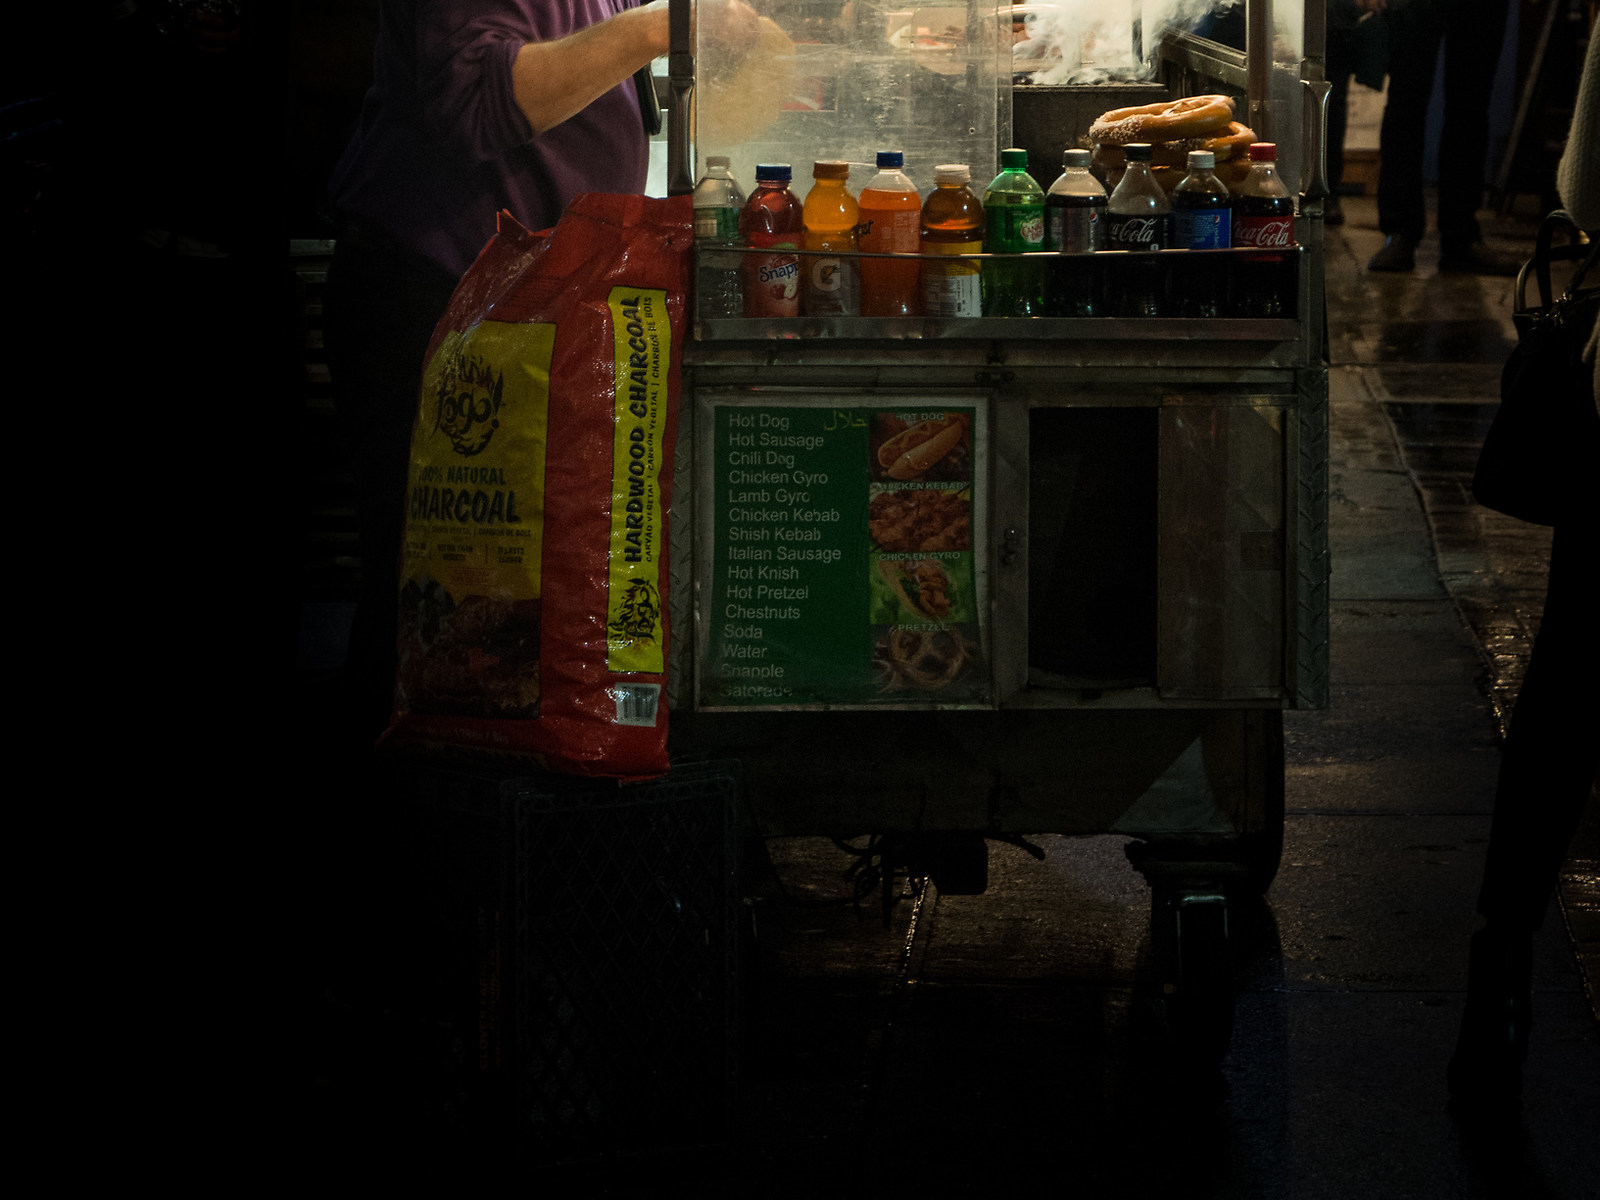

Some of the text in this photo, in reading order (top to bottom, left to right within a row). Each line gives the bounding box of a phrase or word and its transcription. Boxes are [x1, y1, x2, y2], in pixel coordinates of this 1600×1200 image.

[729, 413, 790, 431] Hot Dog
[921, 412, 945, 421] DOG
[621, 295, 649, 563] HARDWOOD CHARCOAL
[729, 432, 824, 450] Hot Sausage
[728, 450, 795, 469] Chili Dog
[447, 465, 506, 486] NATURAL
[728, 470, 829, 487] Chicken Gyro
[729, 488, 770, 503] Lamb
[411, 485, 521, 524] CHARCOAL
[728, 507, 840, 522] Chicken Kebab
[729, 526, 821, 541] Shish Kebab
[728, 546, 842, 564] Italian Sausage
[880, 551, 961, 561] CHICKEN GYRO
[727, 565, 799, 580] Hot Knish
[726, 585, 809, 599] Hot Pretzel
[725, 604, 801, 619] Chestnuts
[723, 623, 763, 639] Soda
[898, 623, 949, 632] PRETZEL
[722, 644, 767, 659] Water
